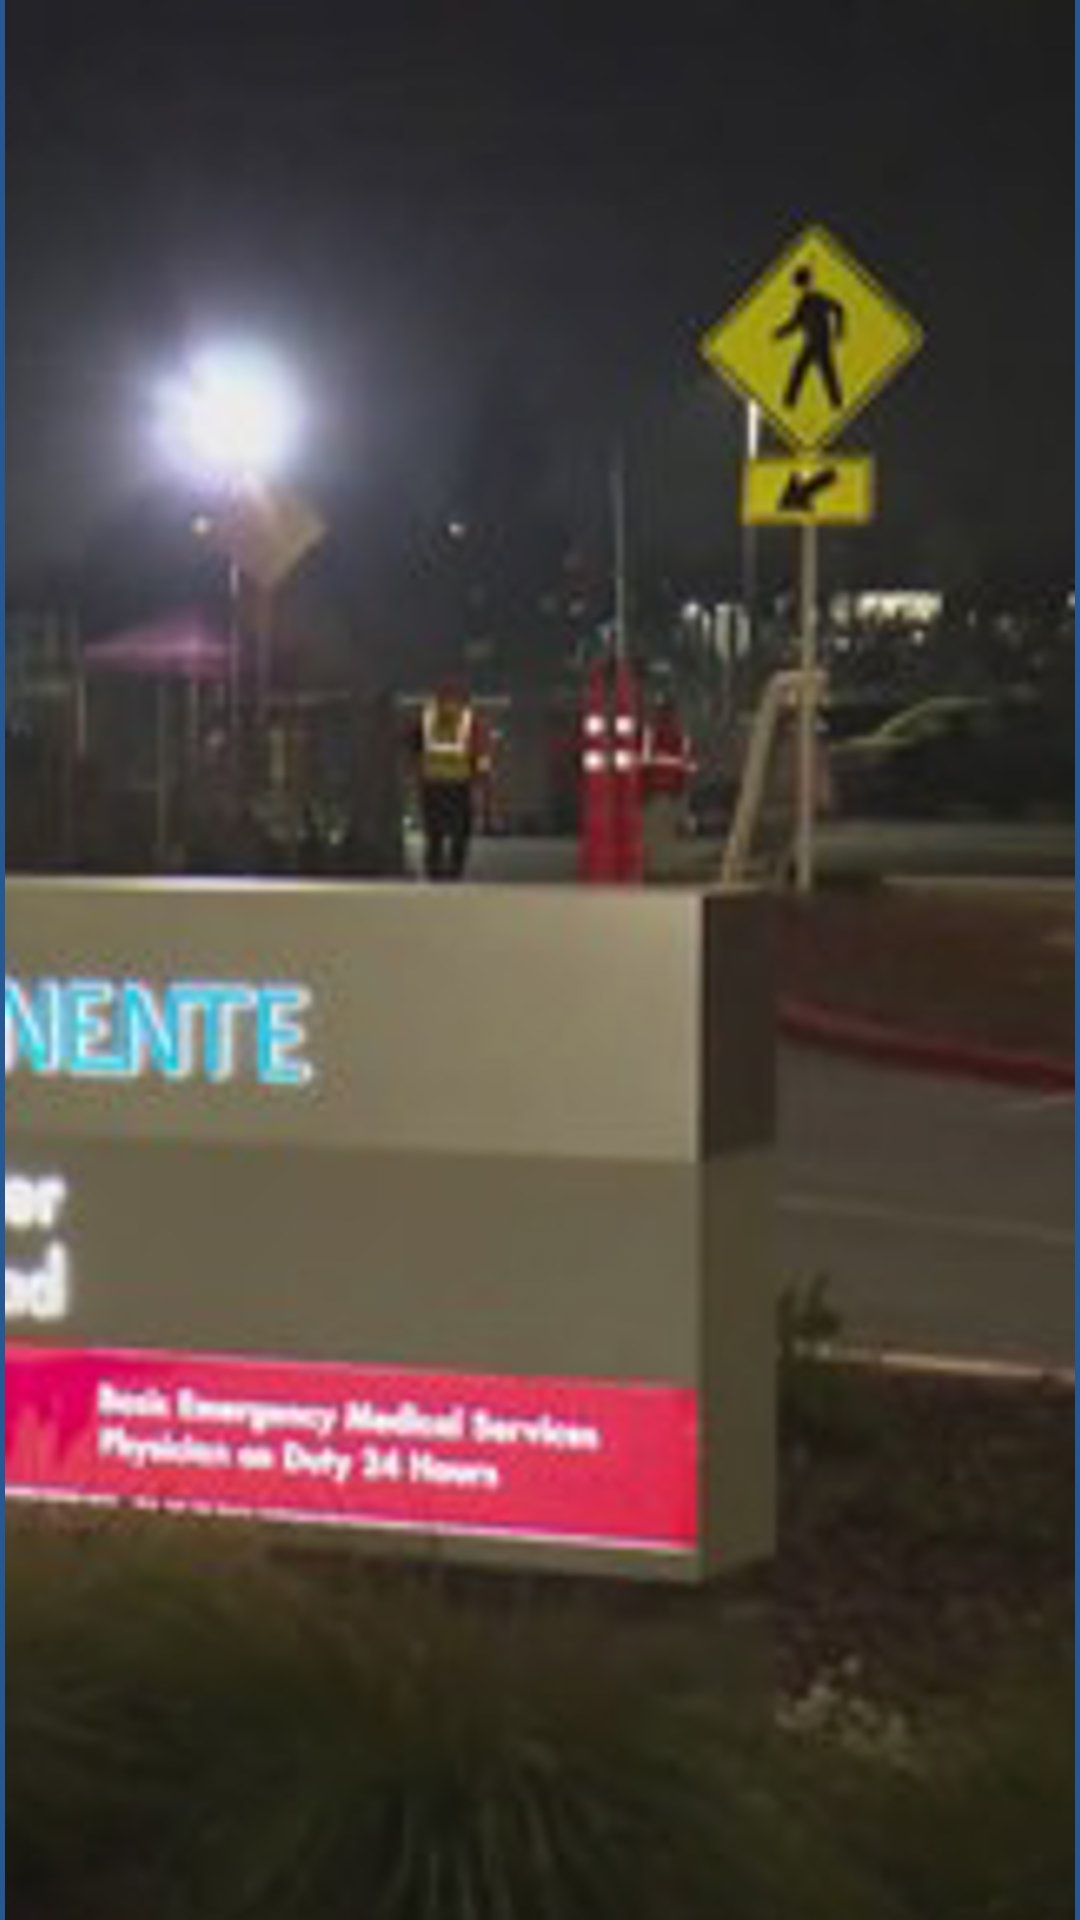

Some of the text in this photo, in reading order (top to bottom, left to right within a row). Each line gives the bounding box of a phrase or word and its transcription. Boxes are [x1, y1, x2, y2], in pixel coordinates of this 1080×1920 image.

[98, 1380, 600, 1450] Basic Emergency Medical Services
[98, 1427, 499, 1490] Physician on Duty 24 Hours
